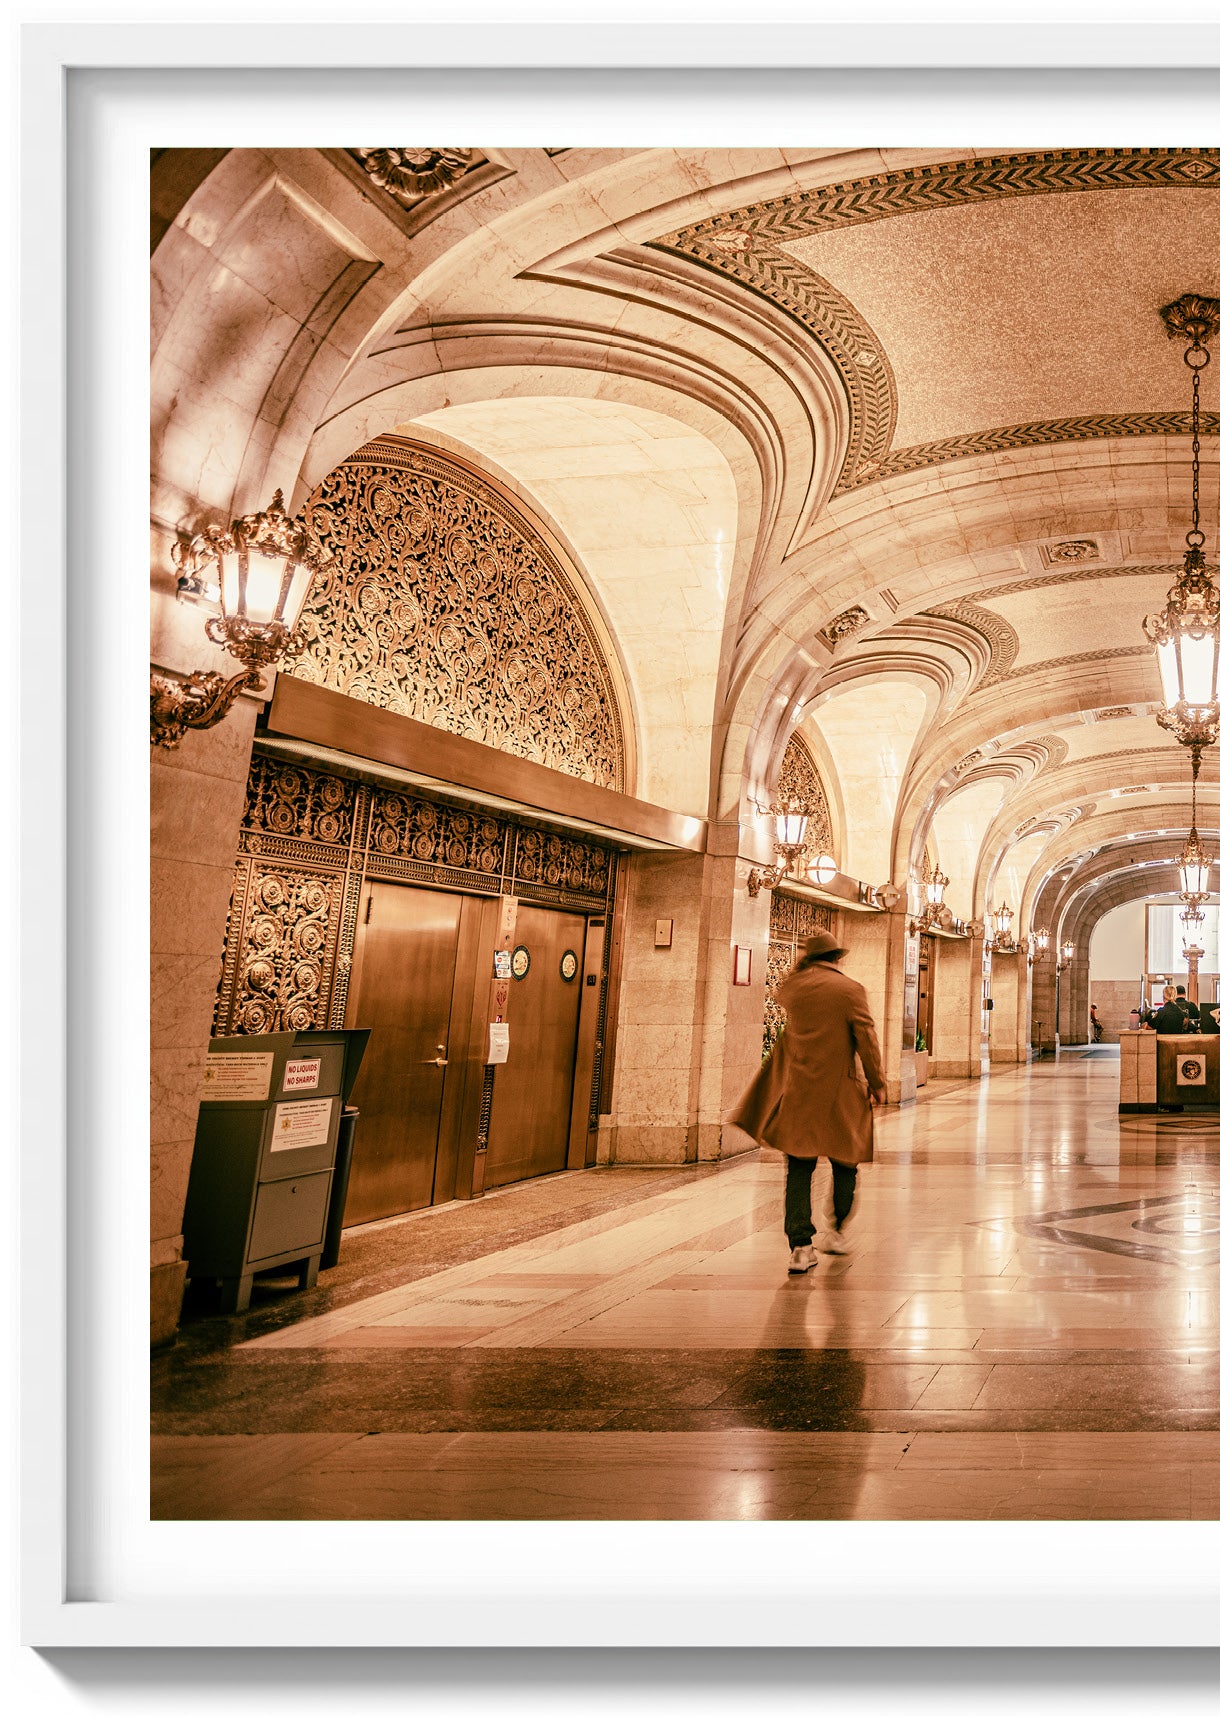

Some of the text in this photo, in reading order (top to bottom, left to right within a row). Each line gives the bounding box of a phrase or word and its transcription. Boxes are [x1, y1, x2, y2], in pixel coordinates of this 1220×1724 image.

[288, 1064, 317, 1073] NO LIQUIDS
[287, 1075, 316, 1085] NO SHARPS
